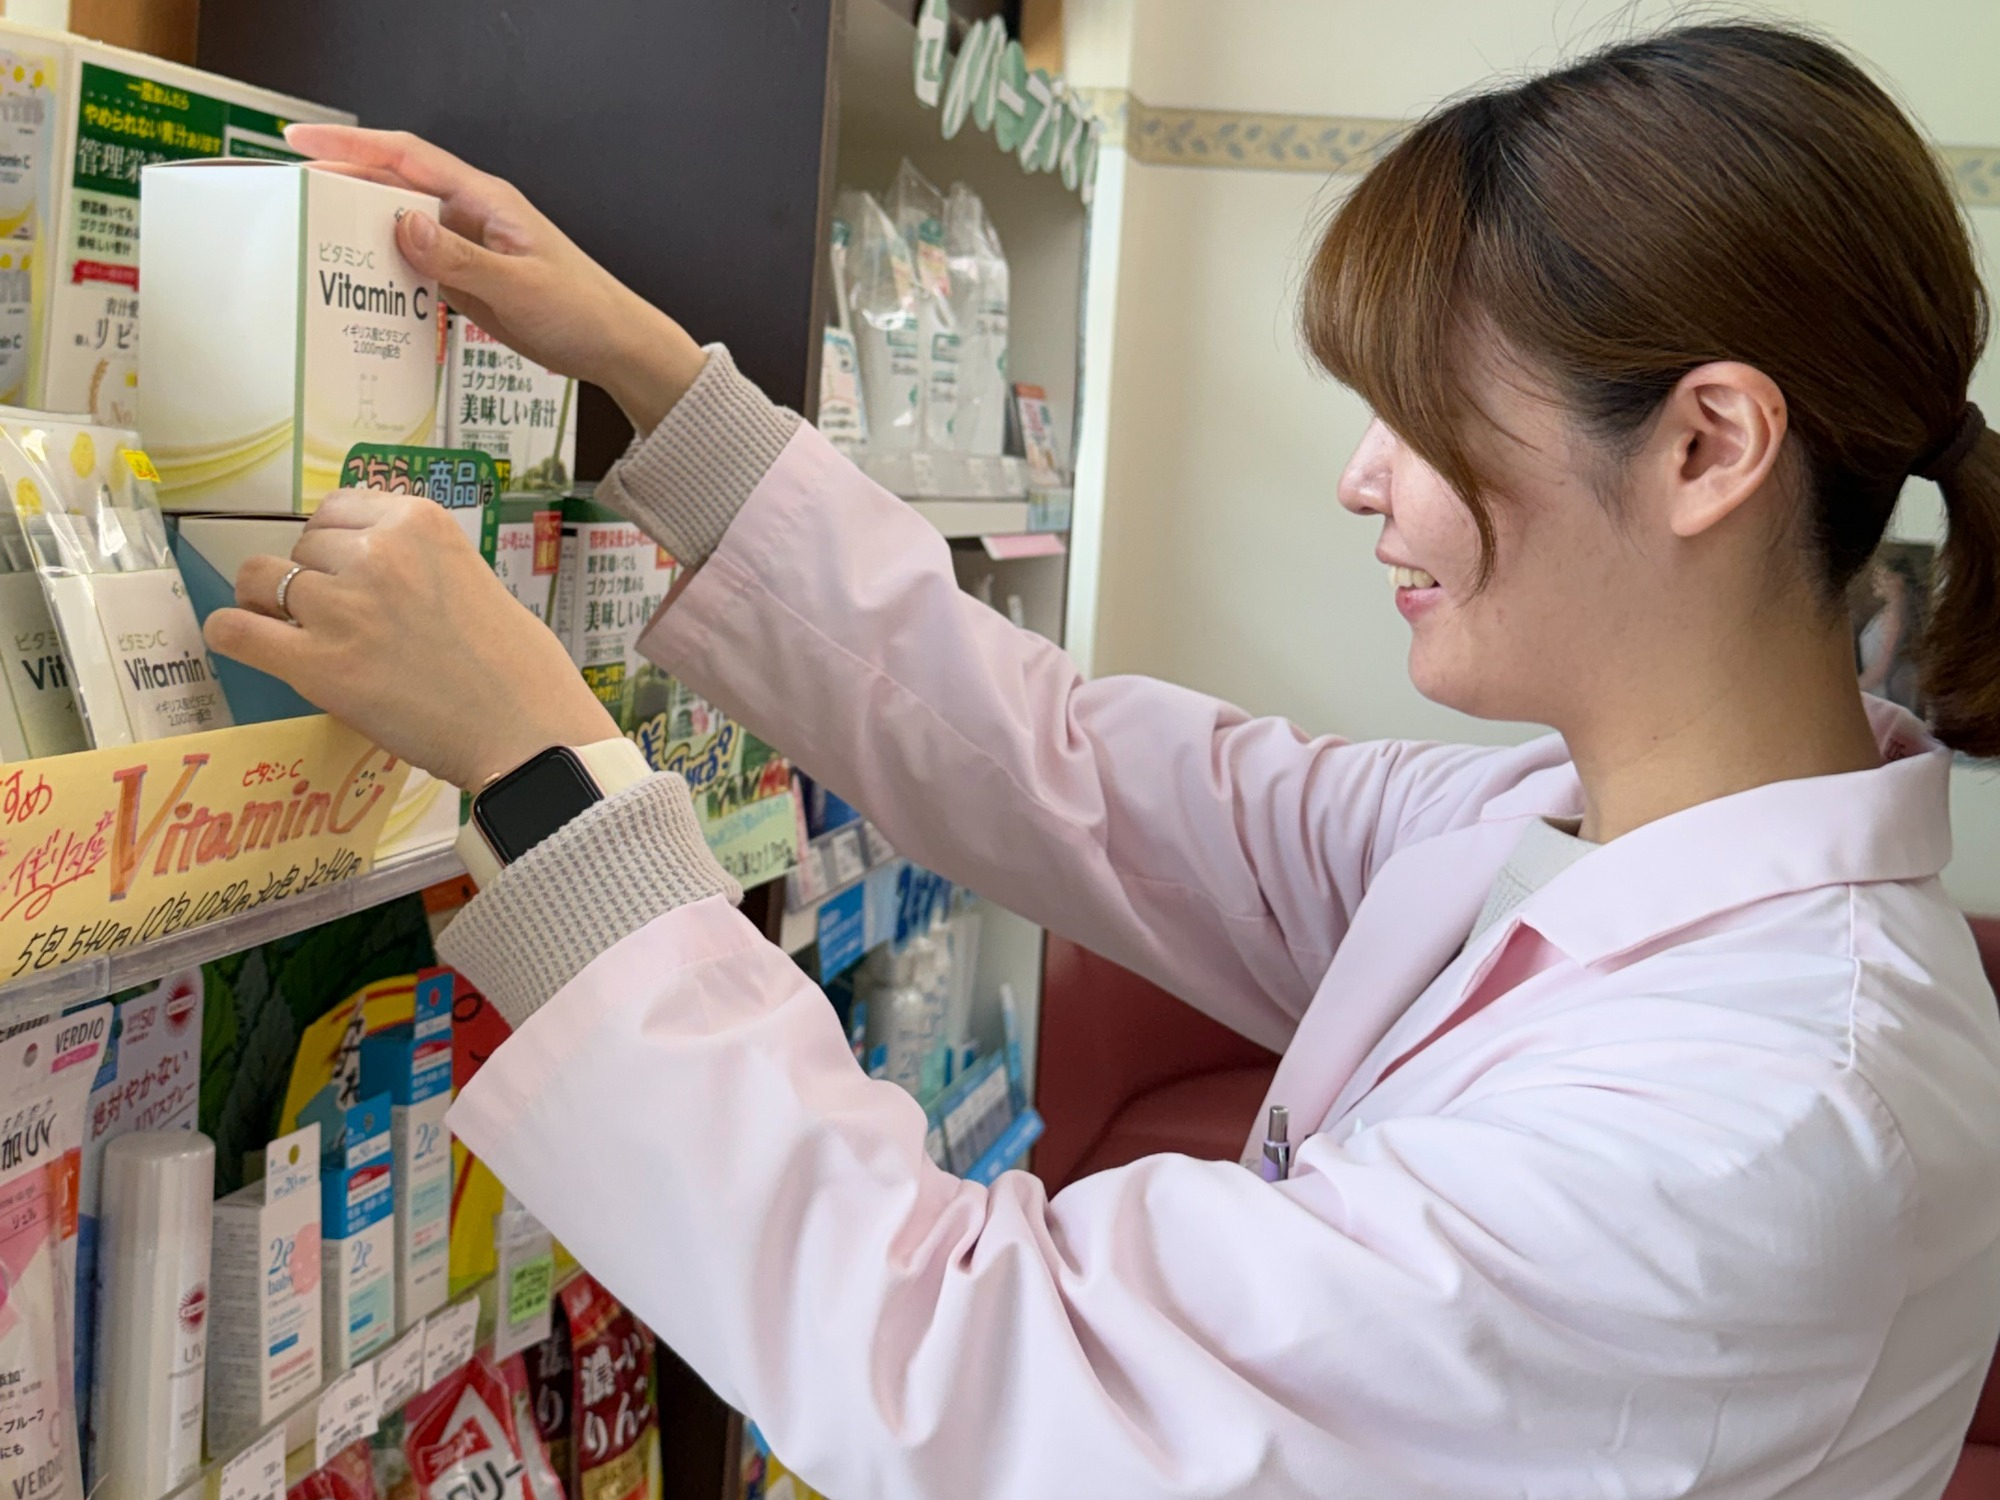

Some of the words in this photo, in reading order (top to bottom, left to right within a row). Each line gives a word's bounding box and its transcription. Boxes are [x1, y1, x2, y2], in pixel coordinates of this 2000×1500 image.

[319, 242, 375, 270] ビタミンC
[319, 270, 406, 318] Vitamin
[413, 286, 429, 321] C
[462, 371, 533, 393] ゴクゴク飲める
[460, 394, 557, 429] 美味しい青汁
[124, 650, 206, 691] Vitamin
[56, 1016, 105, 1054] VERDIO
